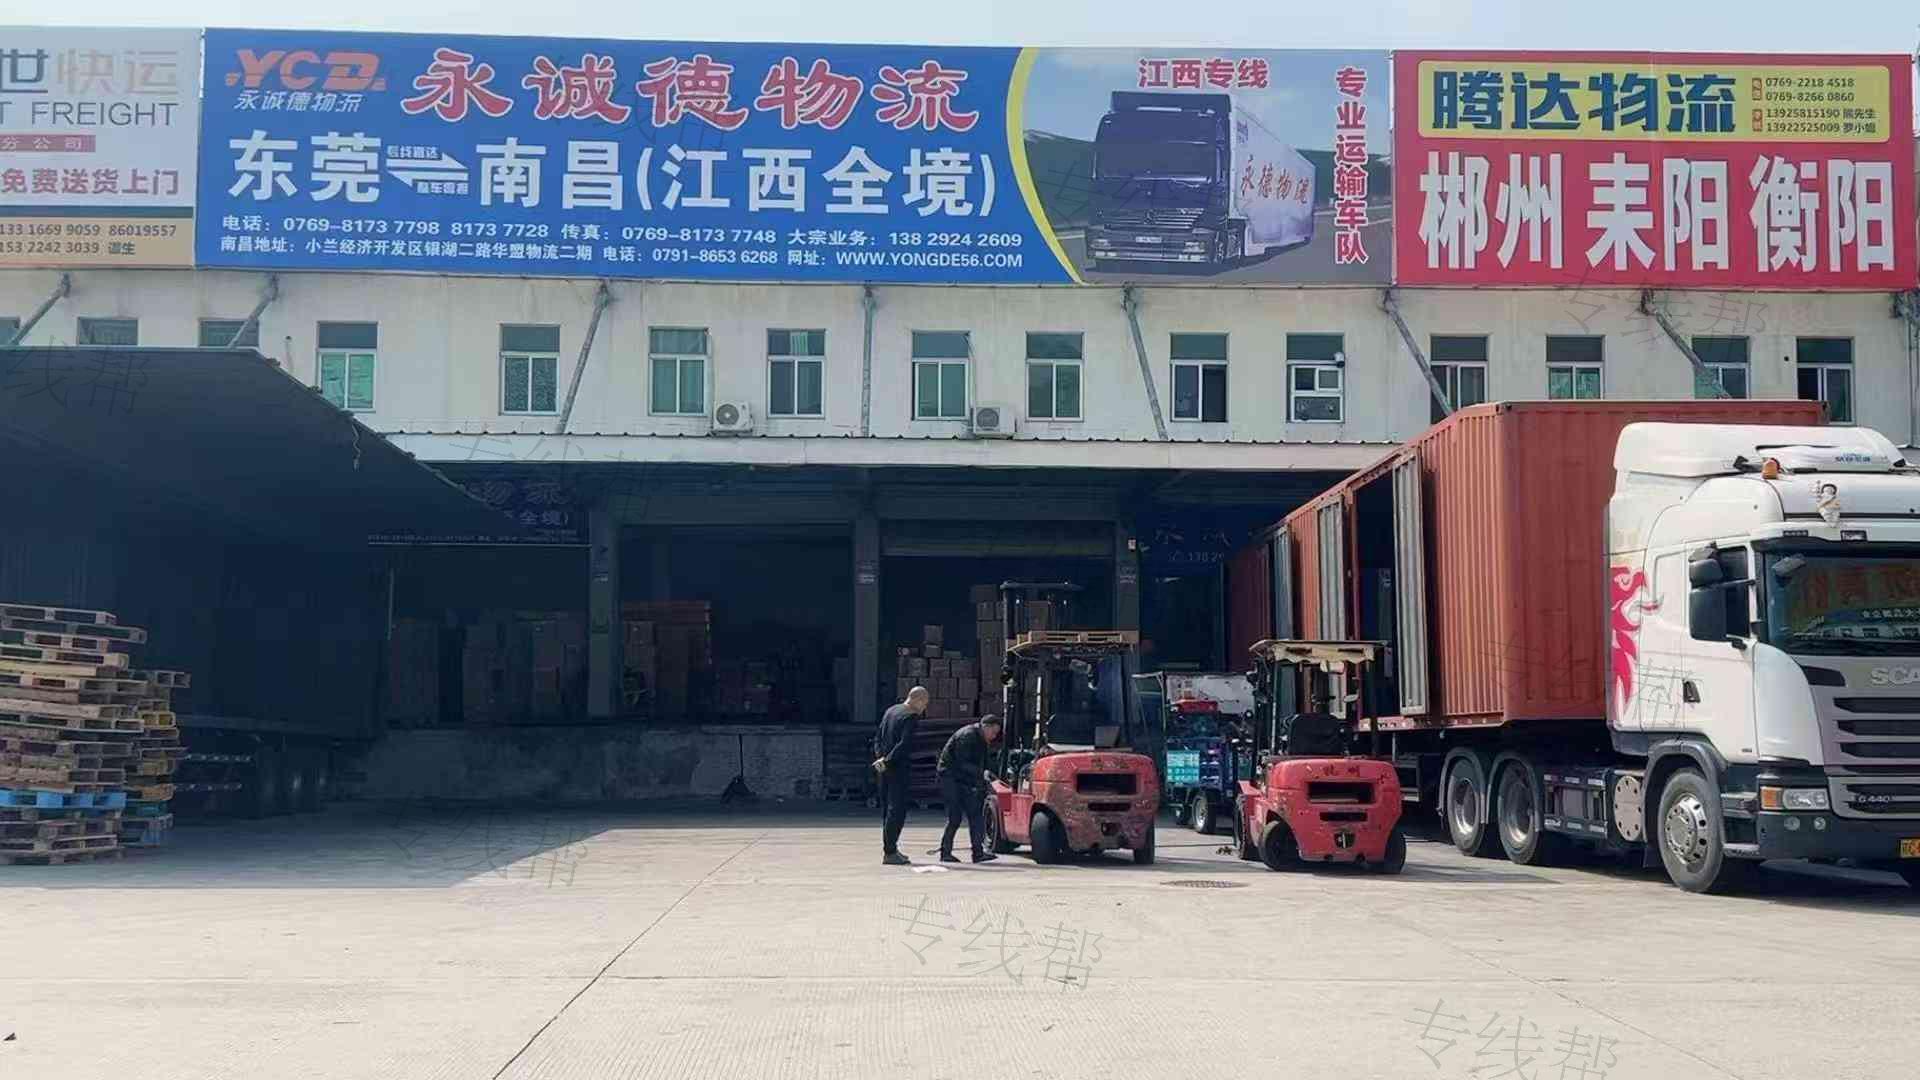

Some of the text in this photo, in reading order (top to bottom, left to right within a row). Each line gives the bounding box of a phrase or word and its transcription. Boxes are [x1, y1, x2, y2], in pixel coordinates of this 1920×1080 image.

[236, 49, 379, 90] YCD
[1138, 58, 1268, 89] 江西专线
[1827, 78, 1855, 88] 4518
[233, 90, 364, 113] 永诚德物流
[400, 47, 980, 132] 永诚德物流
[1432, 70, 1737, 133] 腾达物流
[32, 101, 179, 127] FREIGHT
[228, 129, 382, 203] 东莞
[476, 137, 996, 217] 南昌(江西全境)
[1335, 67, 1369, 264] 专业运输车队
[1, 168, 179, 195] 免费送货上门
[1418, 151, 1895, 272] 郴州 耒阳 衡阳
[28, 224, 61, 236] 1669
[66, 224, 100, 236] 9059
[283, 217, 388, 233] 0769-8173
[394, 220, 440, 235] 7798
[451, 222, 497, 237] 8173
[503, 223, 549, 238] 7728
[622, 227, 725, 242] 0769-8173
[731, 229, 776, 244] 7748
[888, 232, 921, 246] 138
[927, 232, 972, 246] 2924
[977, 233, 1023, 247] 2609
[652, 248, 736, 264] 0791-8653
[741, 249, 778, 264] 6268
[836, 251, 1023, 268] WWW.YONGDE56.COM
